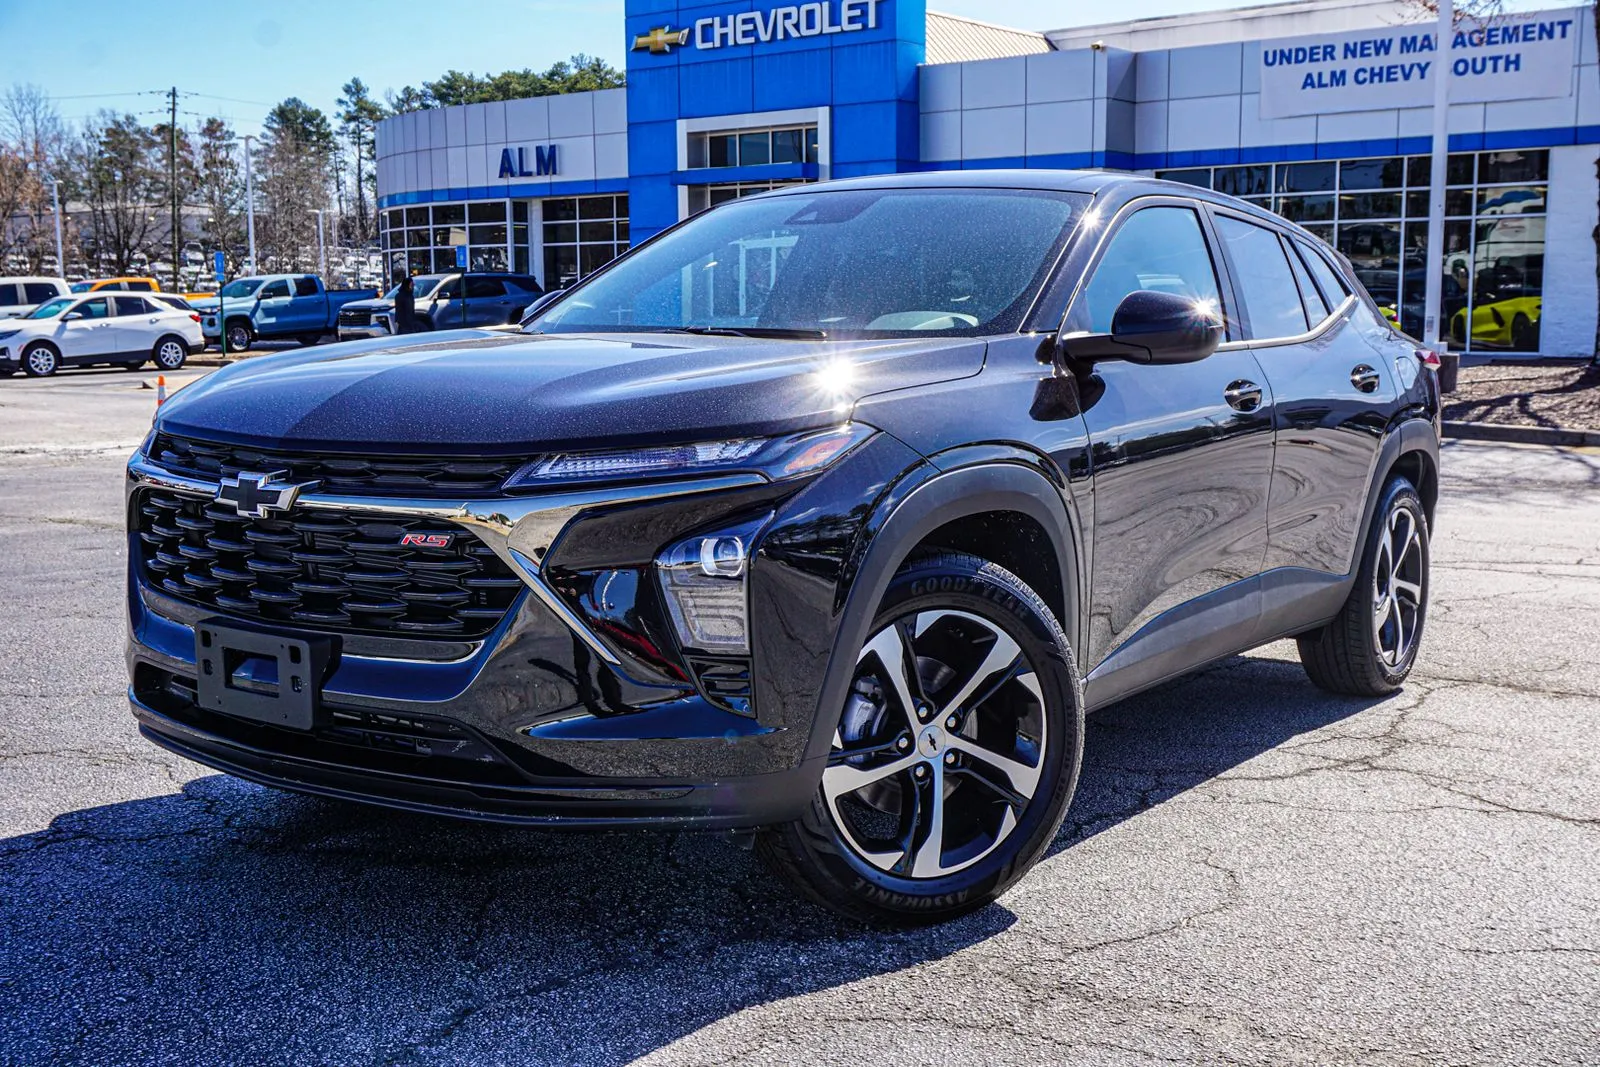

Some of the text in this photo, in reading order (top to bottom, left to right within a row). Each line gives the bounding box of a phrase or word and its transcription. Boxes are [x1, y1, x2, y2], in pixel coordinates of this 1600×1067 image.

[694, 0, 877, 49] CHEVROLET
[1264, 20, 1573, 67] UNDER NEW MAAGEMENT
[1301, 53, 1521, 90] ALM CHEVY OUTH
[498, 144, 558, 178] ALM
[401, 533, 450, 547] RS
